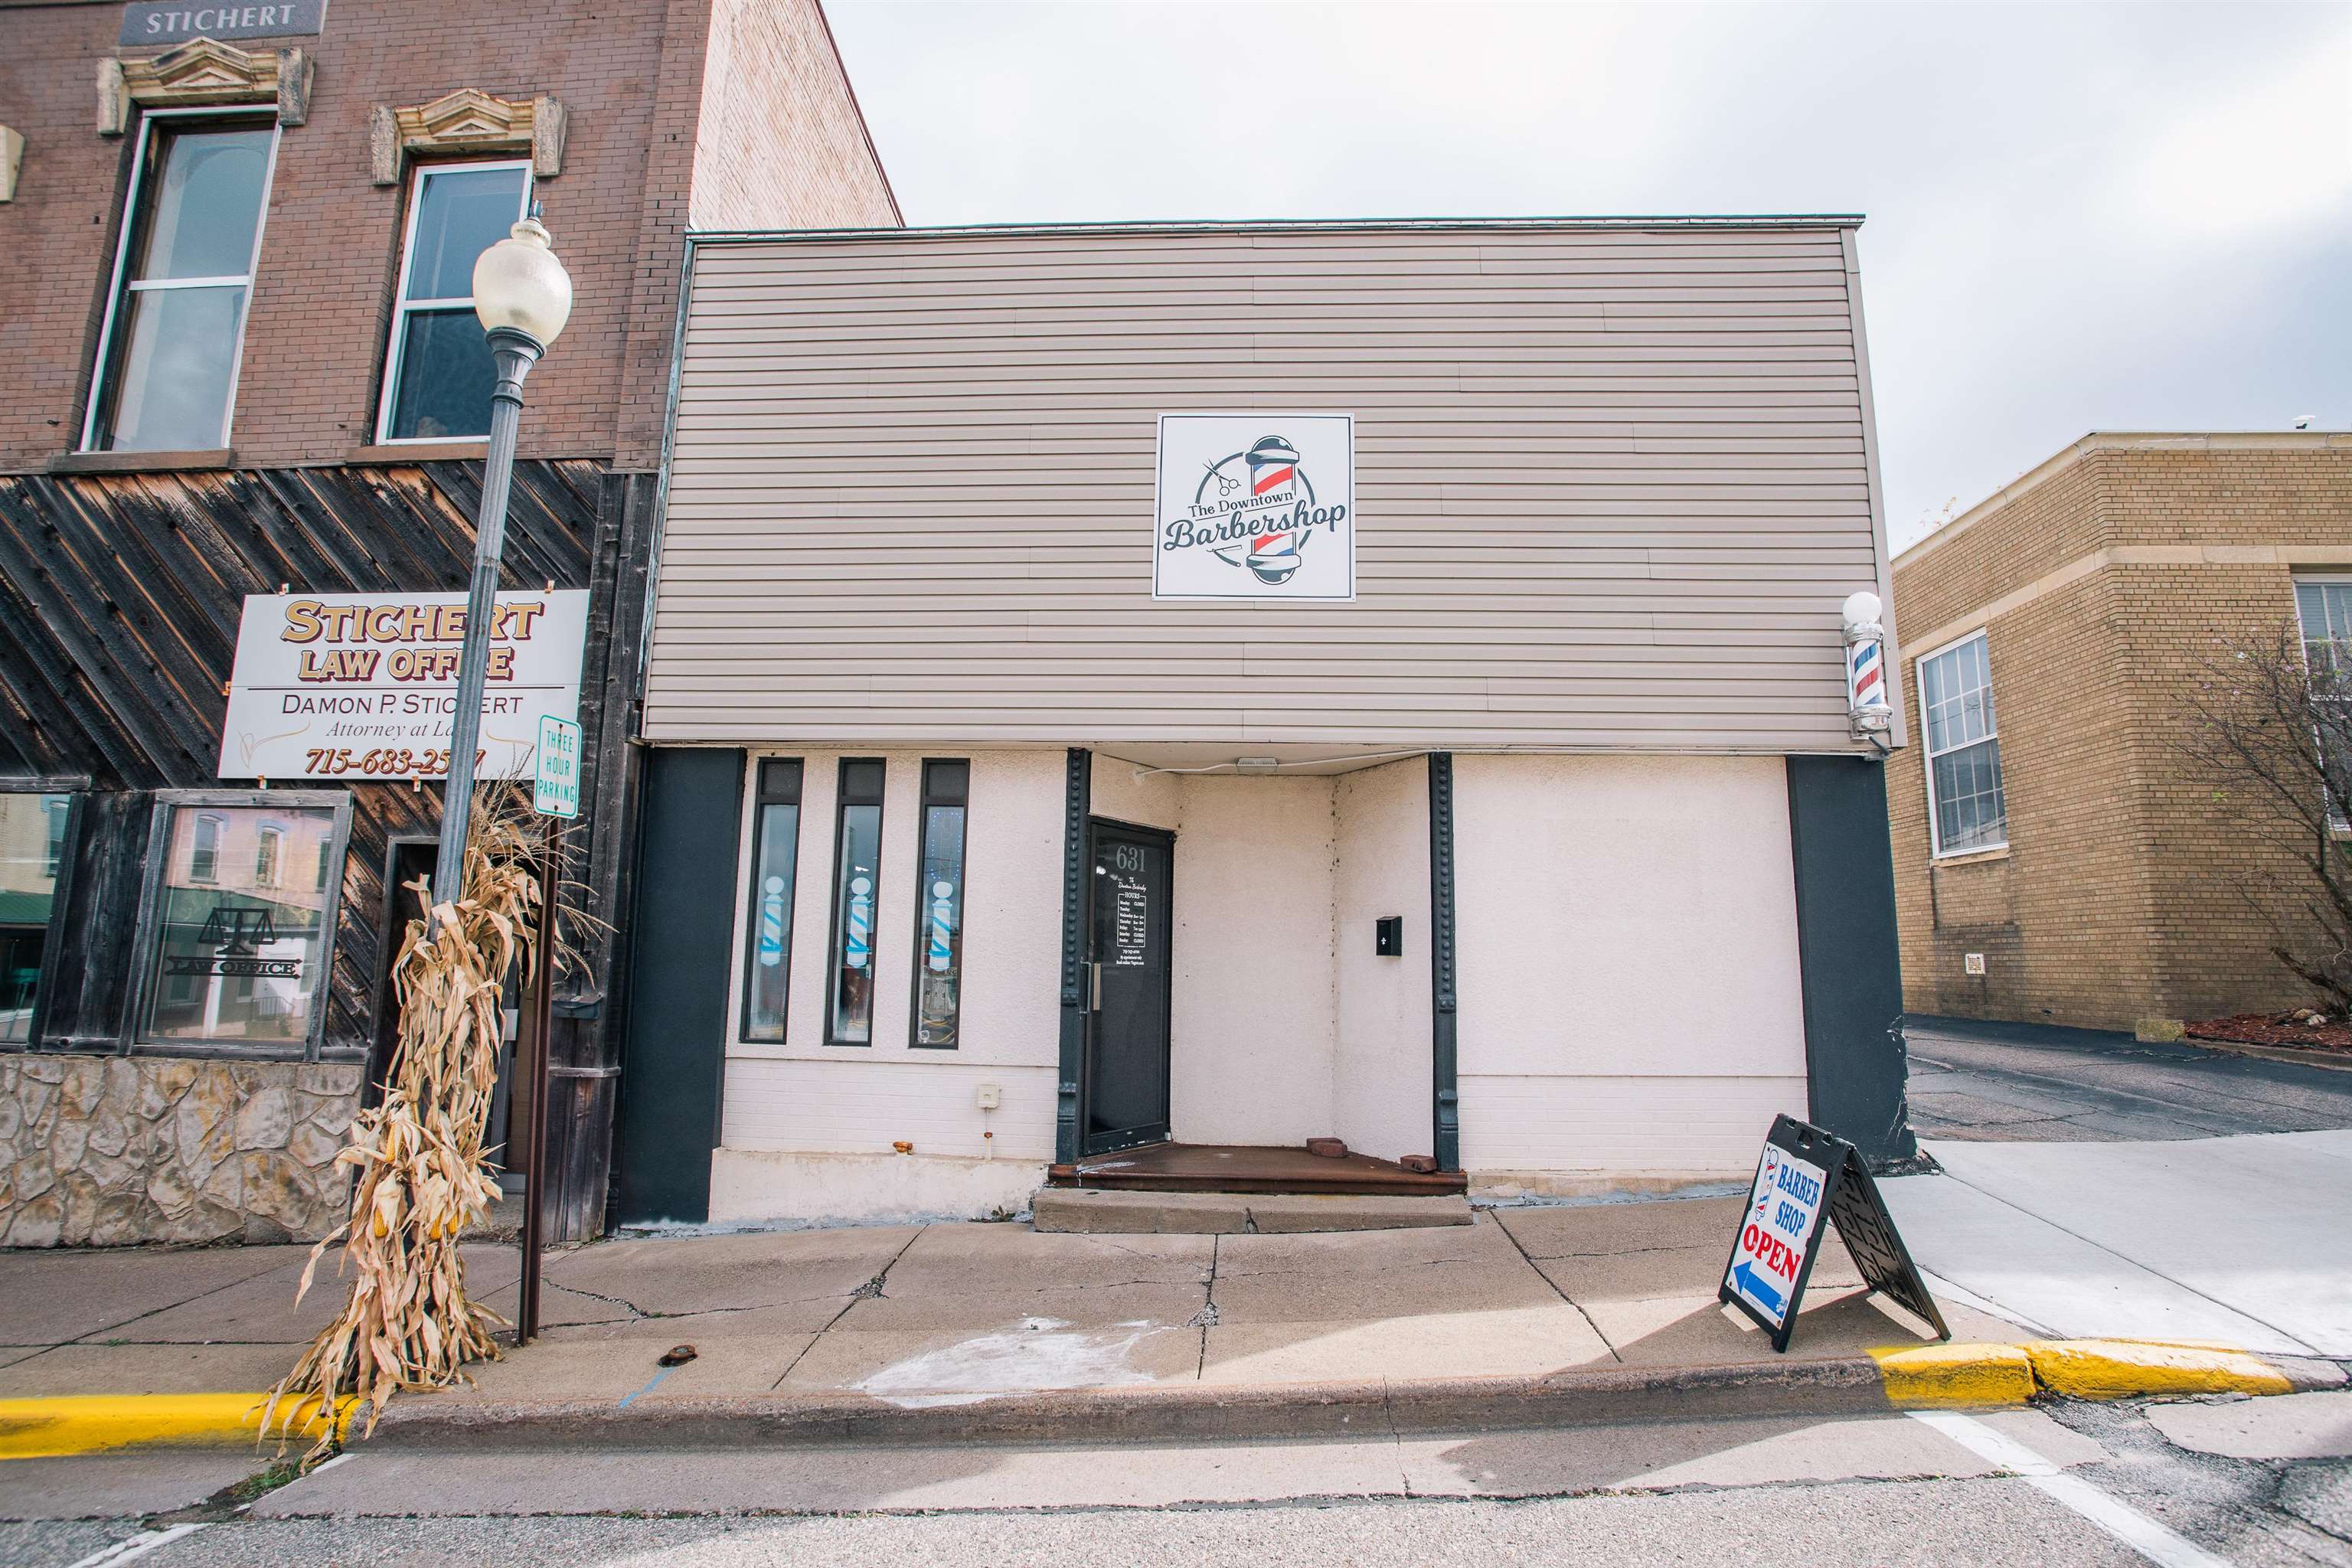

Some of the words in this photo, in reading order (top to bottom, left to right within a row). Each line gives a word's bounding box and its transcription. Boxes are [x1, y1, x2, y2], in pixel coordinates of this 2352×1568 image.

[146, 5, 296, 34] STICHERT
[1187, 505, 1215, 518] The
[1219, 491, 1294, 513] Downtown
[1163, 498, 1346, 551] Barbershop
[299, 649, 381, 682] LAW
[282, 694, 373, 714] DAMON
[380, 694, 394, 714] P.
[403, 694, 524, 714] STICERT
[326, 720, 407, 741] Attorney
[410, 723, 430, 737] at
[433, 720, 455, 737] La
[547, 730, 573, 753] THREE
[305, 748, 486, 775] 715-683-257
[546, 756, 570, 776] HOUR
[538, 779, 575, 803] PARKING
[1116, 844, 1146, 873] 631
[172, 960, 217, 973] LAW
[220, 962, 296, 975] OFFICE
[1777, 1163, 1821, 1208] BARBER
[1775, 1200, 1807, 1238] SHOP
[1743, 1223, 1802, 1284] OPEN
